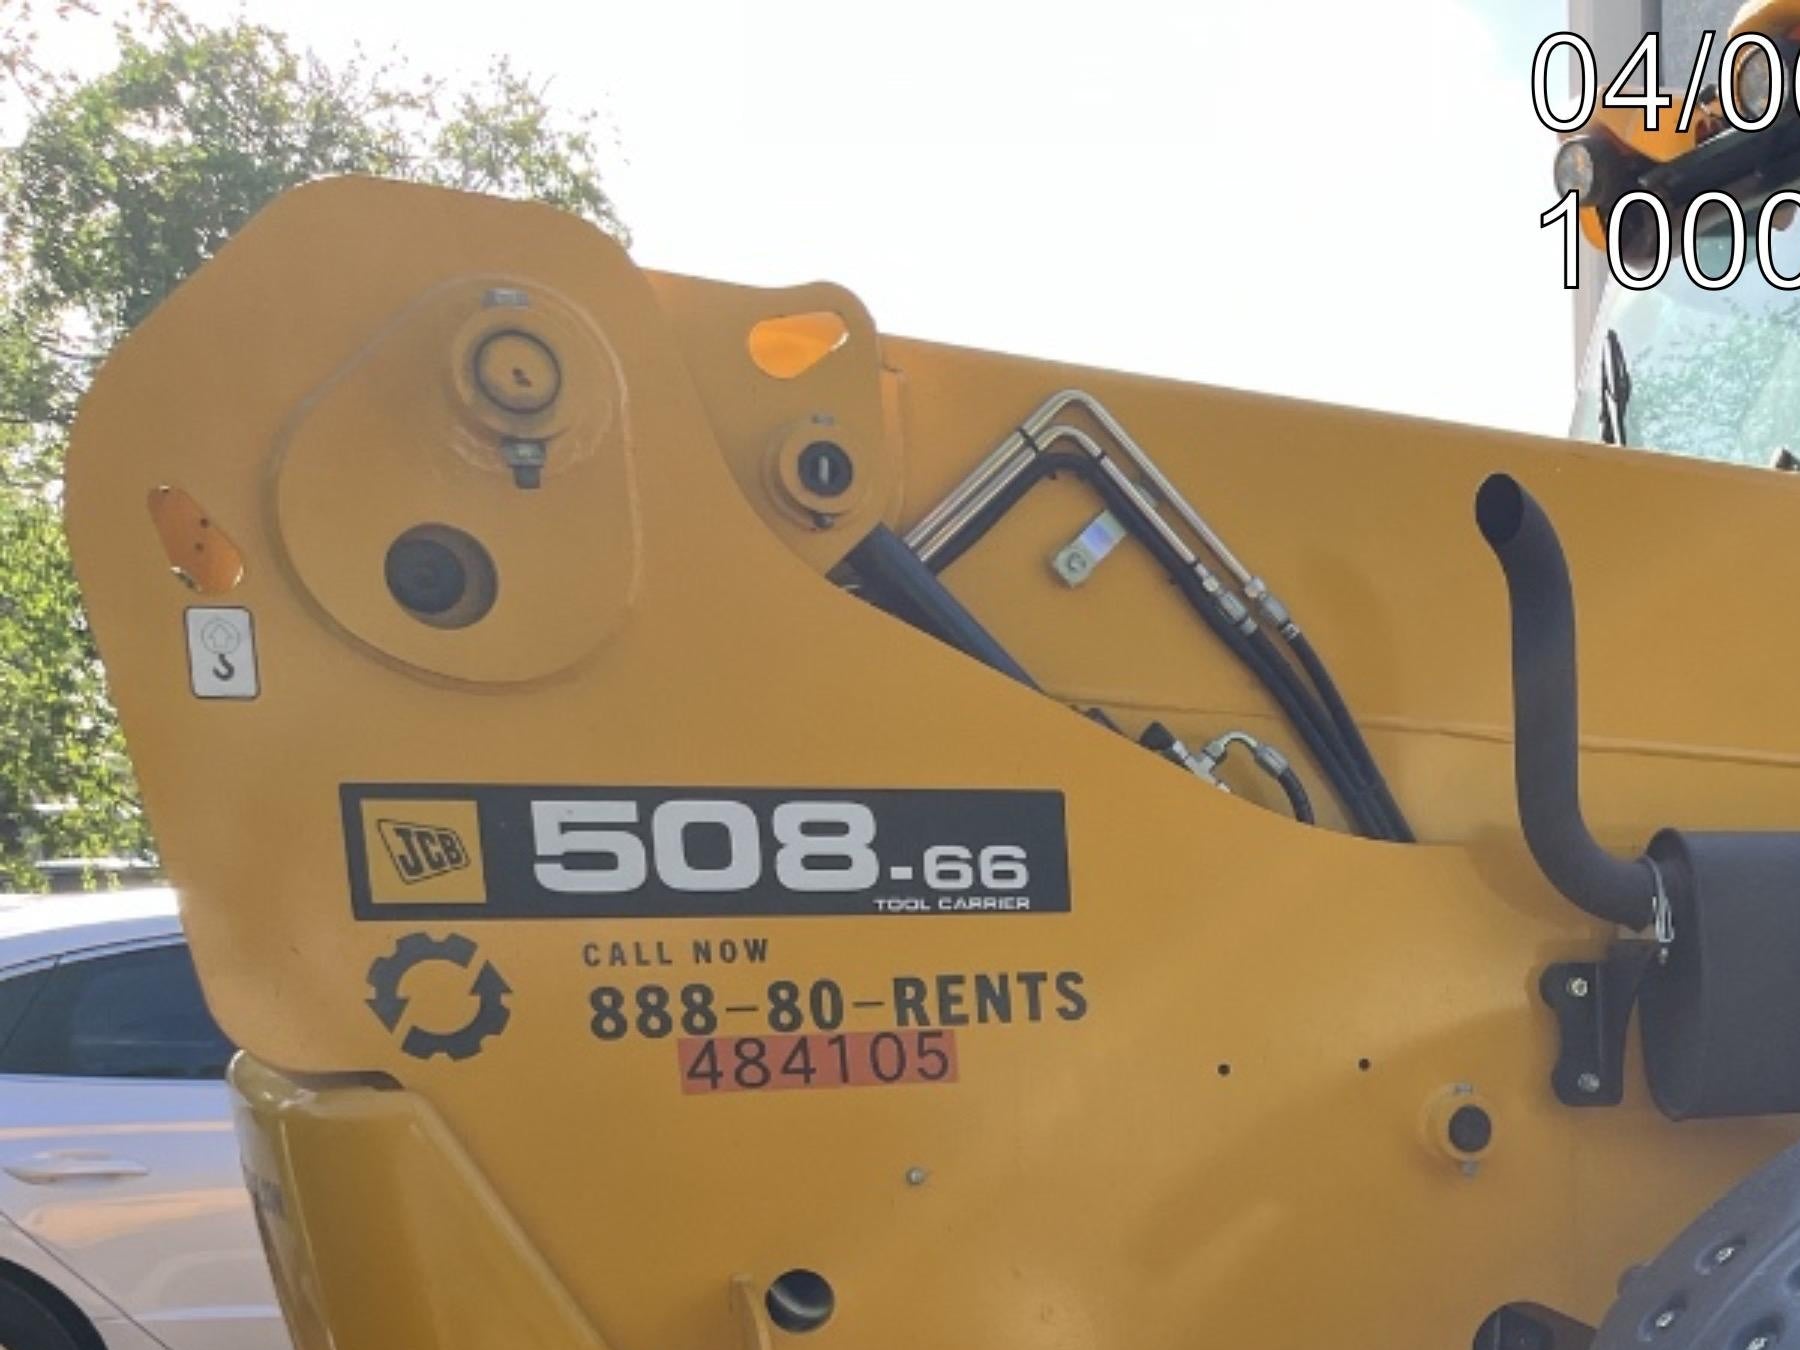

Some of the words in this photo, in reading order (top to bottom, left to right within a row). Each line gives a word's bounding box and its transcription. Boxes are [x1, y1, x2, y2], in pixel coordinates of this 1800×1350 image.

[392, 826, 464, 877] JCB
[873, 896, 931, 912] TOOL
[937, 896, 1031, 911] CARRIER
[583, 941, 674, 968] CALL
[693, 937, 770, 963] NOW
[589, 970, 1089, 1041] 888-80-RENTS
[686, 1029, 951, 1089] 484105
